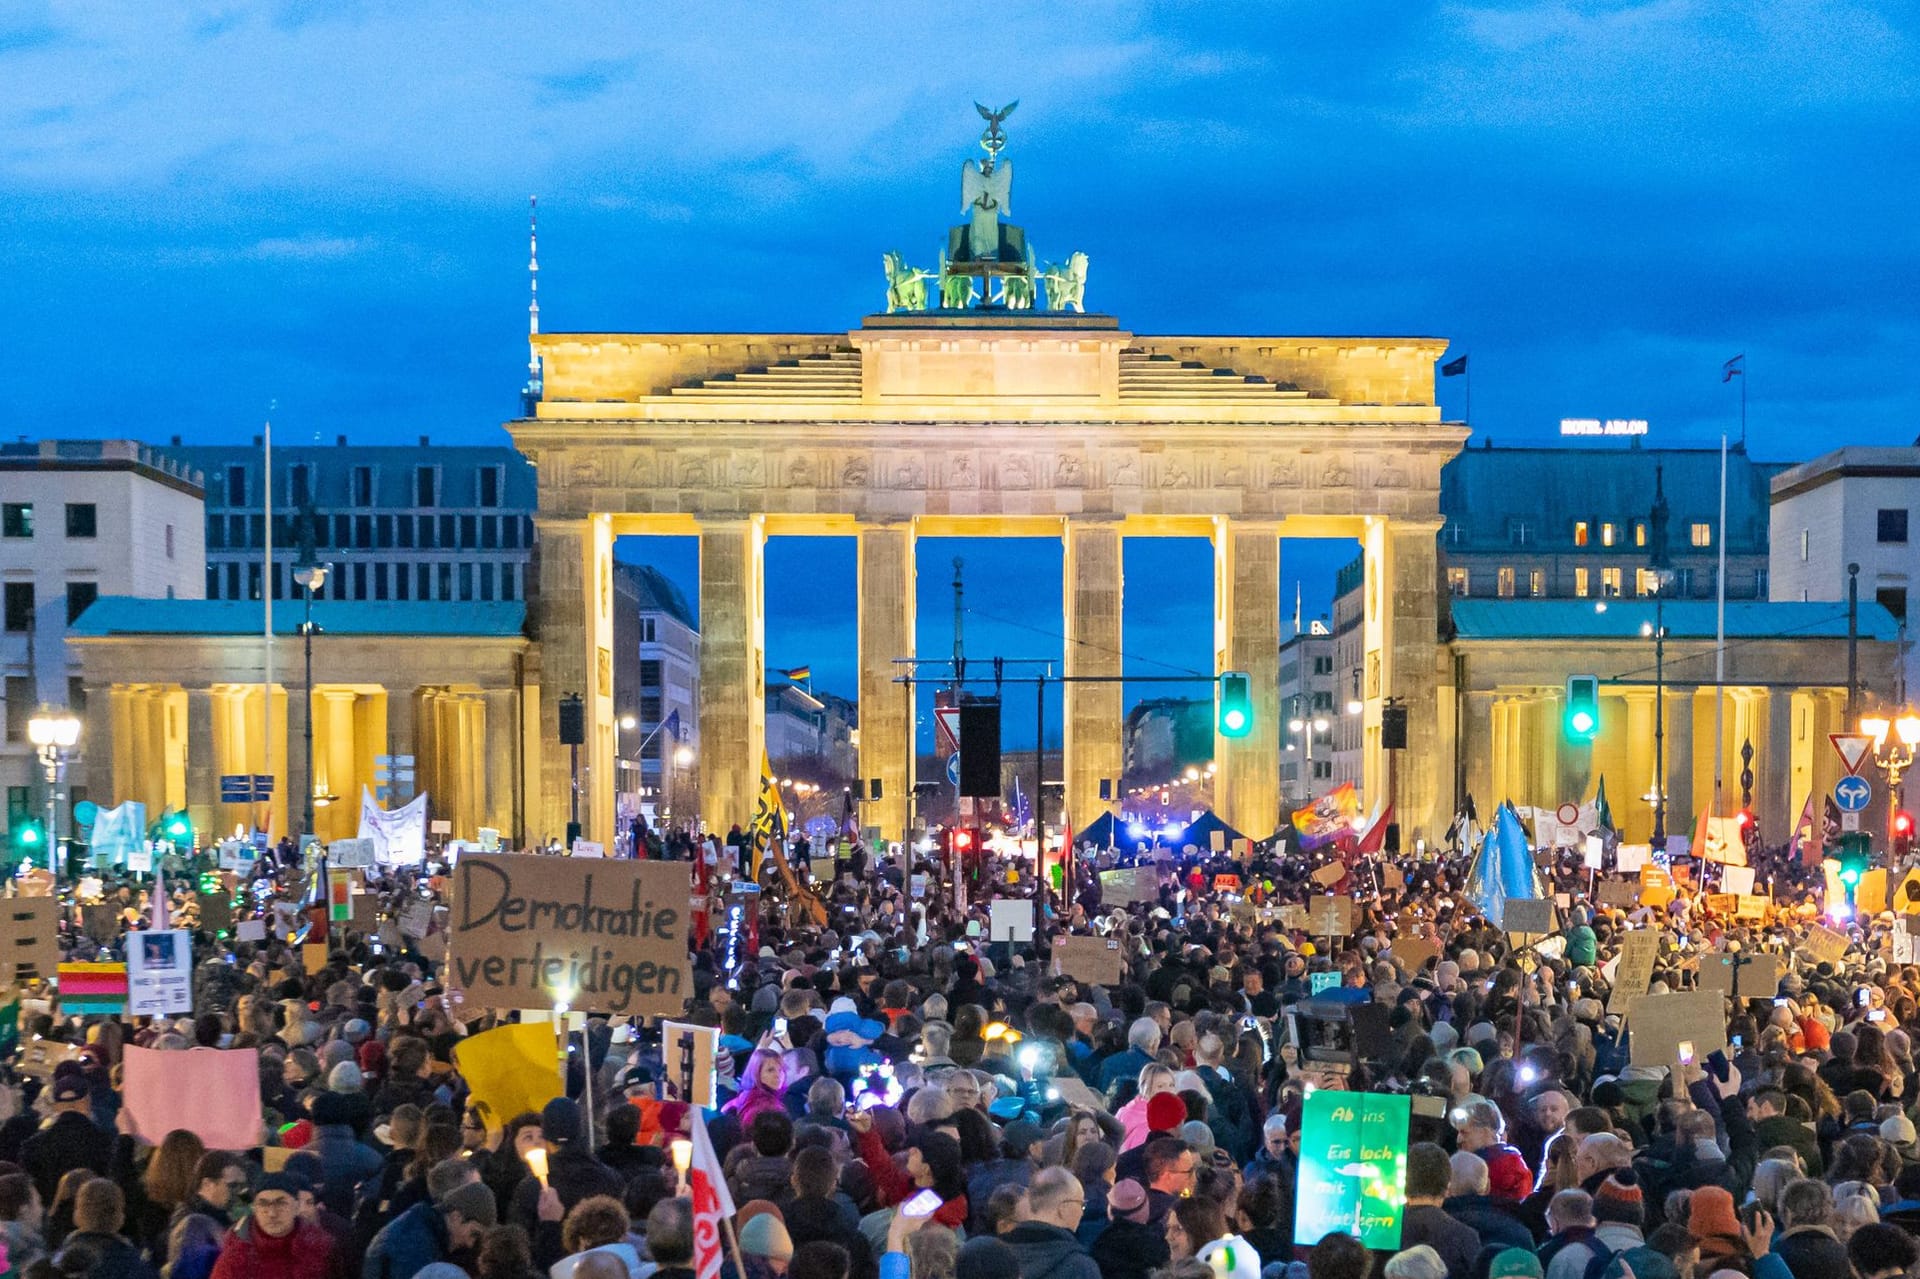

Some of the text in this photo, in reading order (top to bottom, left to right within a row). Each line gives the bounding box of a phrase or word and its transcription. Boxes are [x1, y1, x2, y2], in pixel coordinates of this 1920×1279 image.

[458, 860, 678, 940] Demokratie
[456, 942, 681, 1011] verteidigen
[1331, 1107, 1385, 1122] Ab ins
